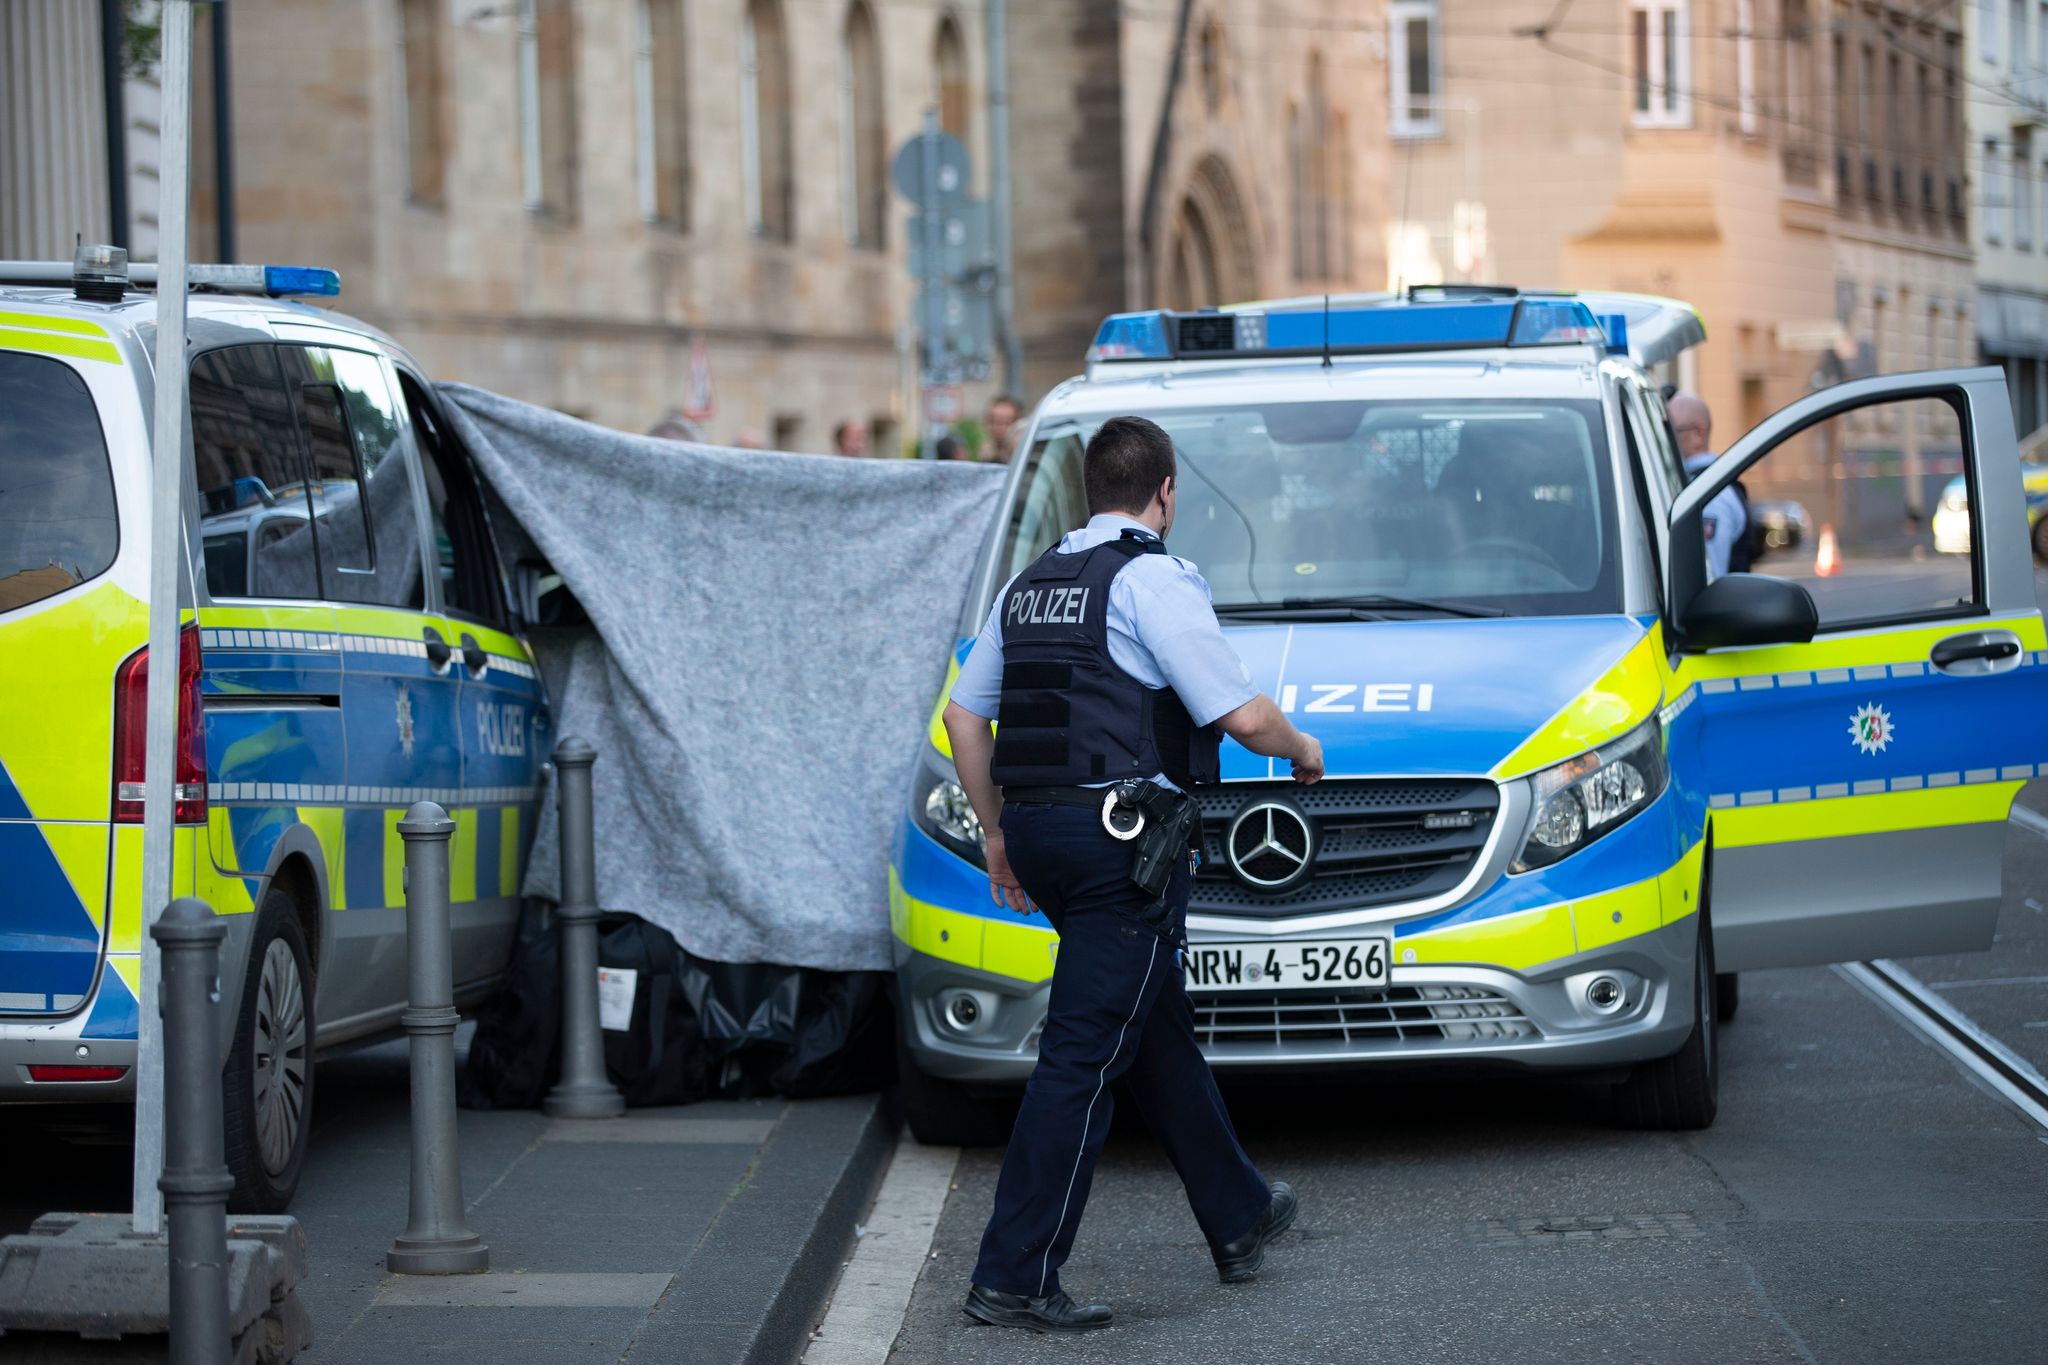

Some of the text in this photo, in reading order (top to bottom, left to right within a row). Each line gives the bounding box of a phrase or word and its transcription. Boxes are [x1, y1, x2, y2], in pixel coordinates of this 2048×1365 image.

[1007, 588, 1089, 627] POLIZEI
[1281, 684, 1433, 712] IZEI
[477, 702, 525, 756] POLIZEI
[1181, 950, 1242, 985] NRW
